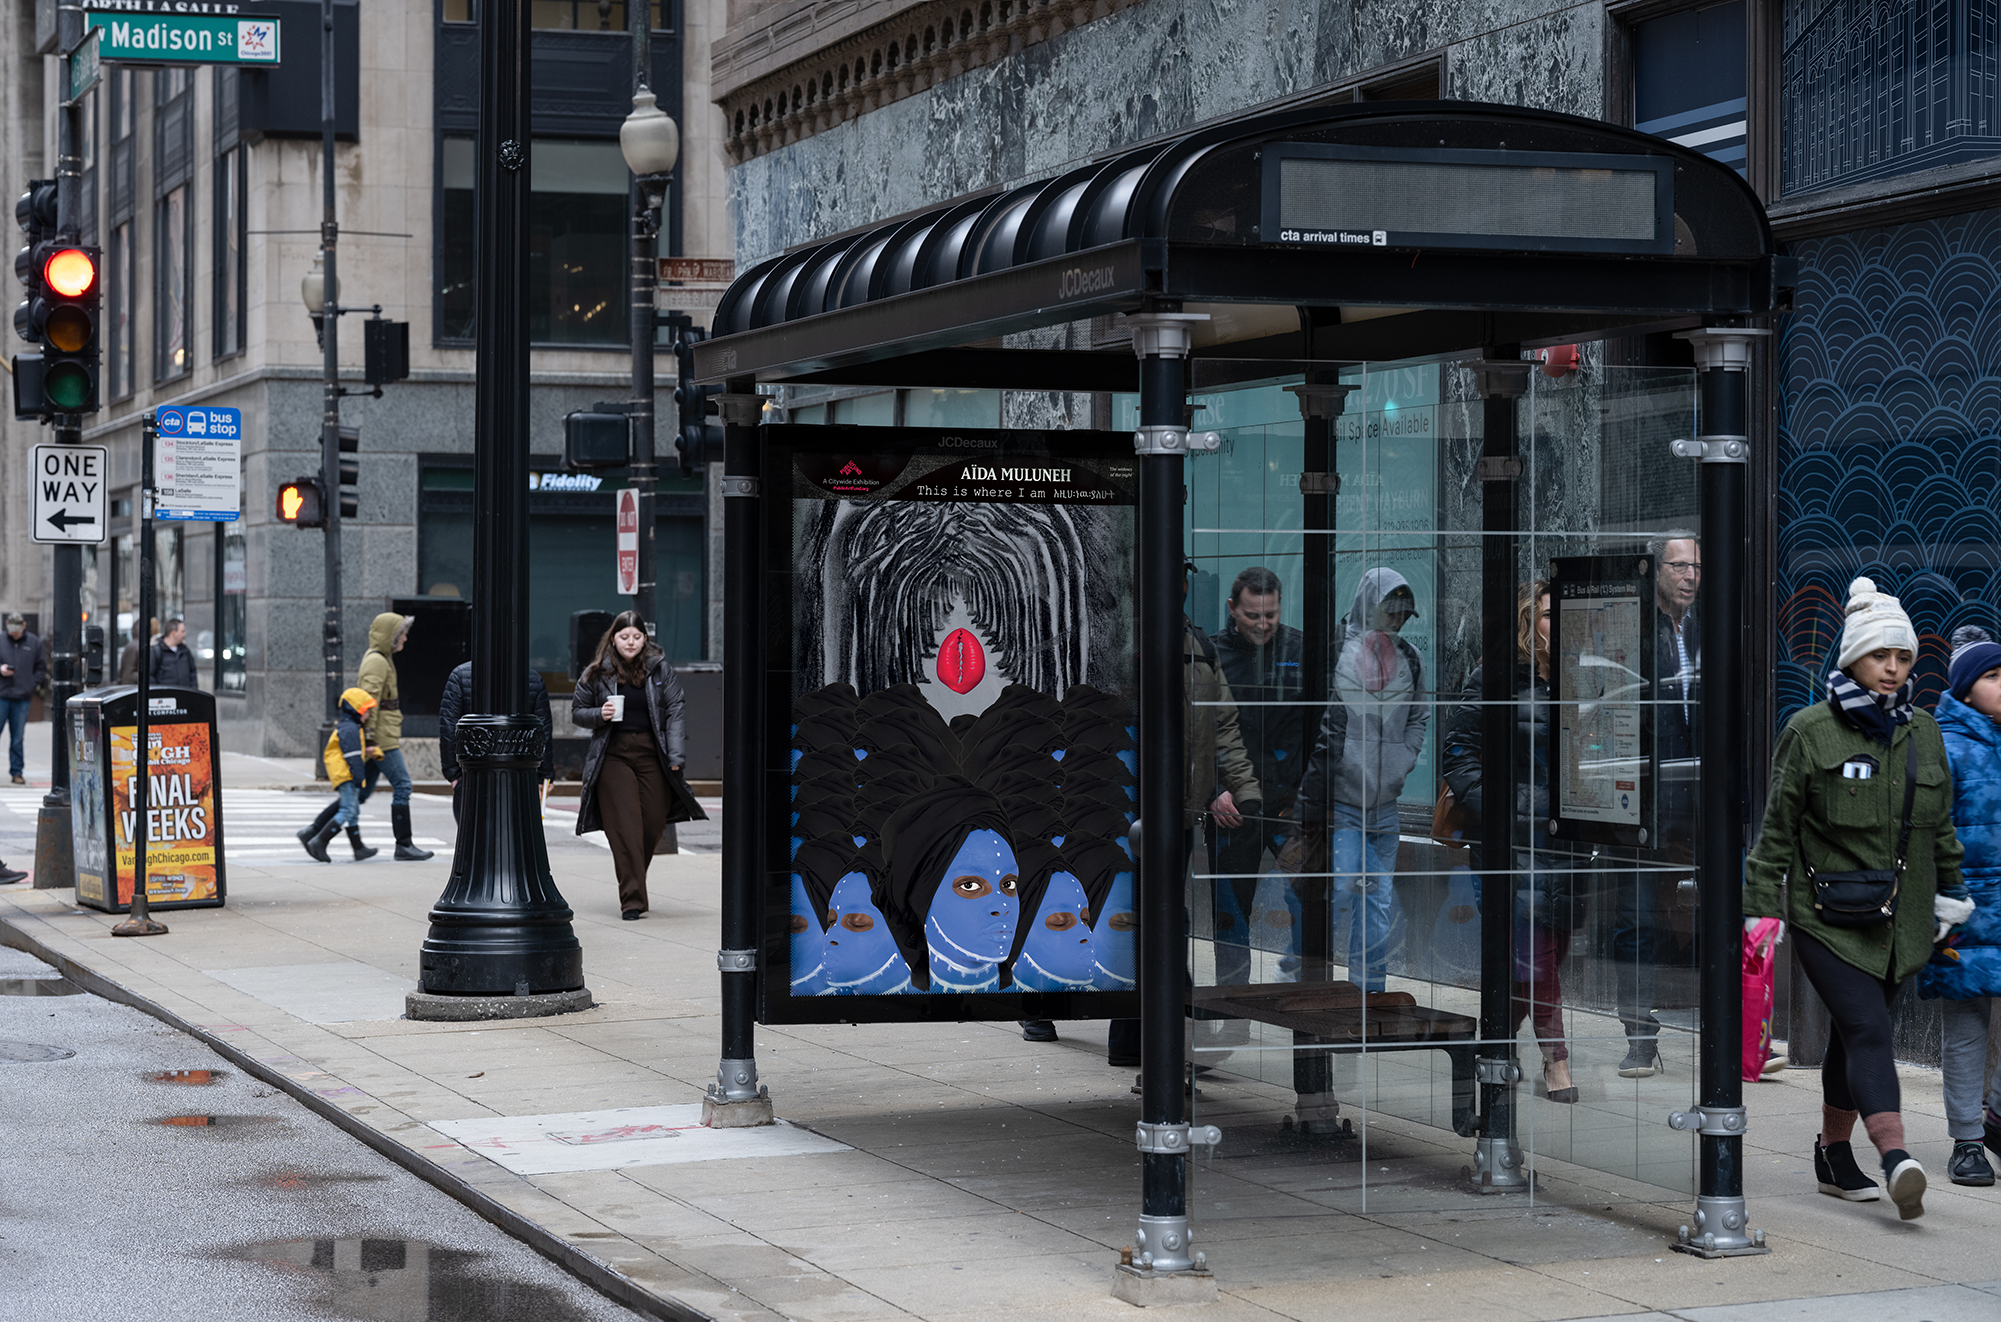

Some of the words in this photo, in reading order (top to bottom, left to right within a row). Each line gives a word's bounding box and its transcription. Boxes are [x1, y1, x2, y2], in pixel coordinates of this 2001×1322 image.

[112, 21, 212, 51] Madison
[217, 32, 233, 46] St
[1280, 229, 1300, 242] cta
[1303, 230, 1337, 243] arrival
[1340, 232, 1370, 244] times
[1059, 264, 1115, 300] JCDecaux
[210, 411, 233, 424] bus
[1197, 394, 1225, 426] ase
[164, 418, 181, 427] cta
[210, 423, 237, 437] stop
[1382, 412, 1429, 437] Available
[938, 436, 998, 449] JCDecaux
[44, 455, 97, 477] ONE
[960, 466, 997, 481] AÏDA
[1001, 468, 1071, 482] MULUNEH
[540, 473, 603, 492] Fidelity
[43, 481, 98, 503] WAY
[917, 485, 948, 497] This
[953, 485, 967, 497] is
[973, 486, 1012, 498] where
[1018, 487, 1025, 498] I
[1030, 489, 1046, 498] am
[128, 773, 199, 809] FNAL
[122, 852, 210, 867] VanghChicago.com
